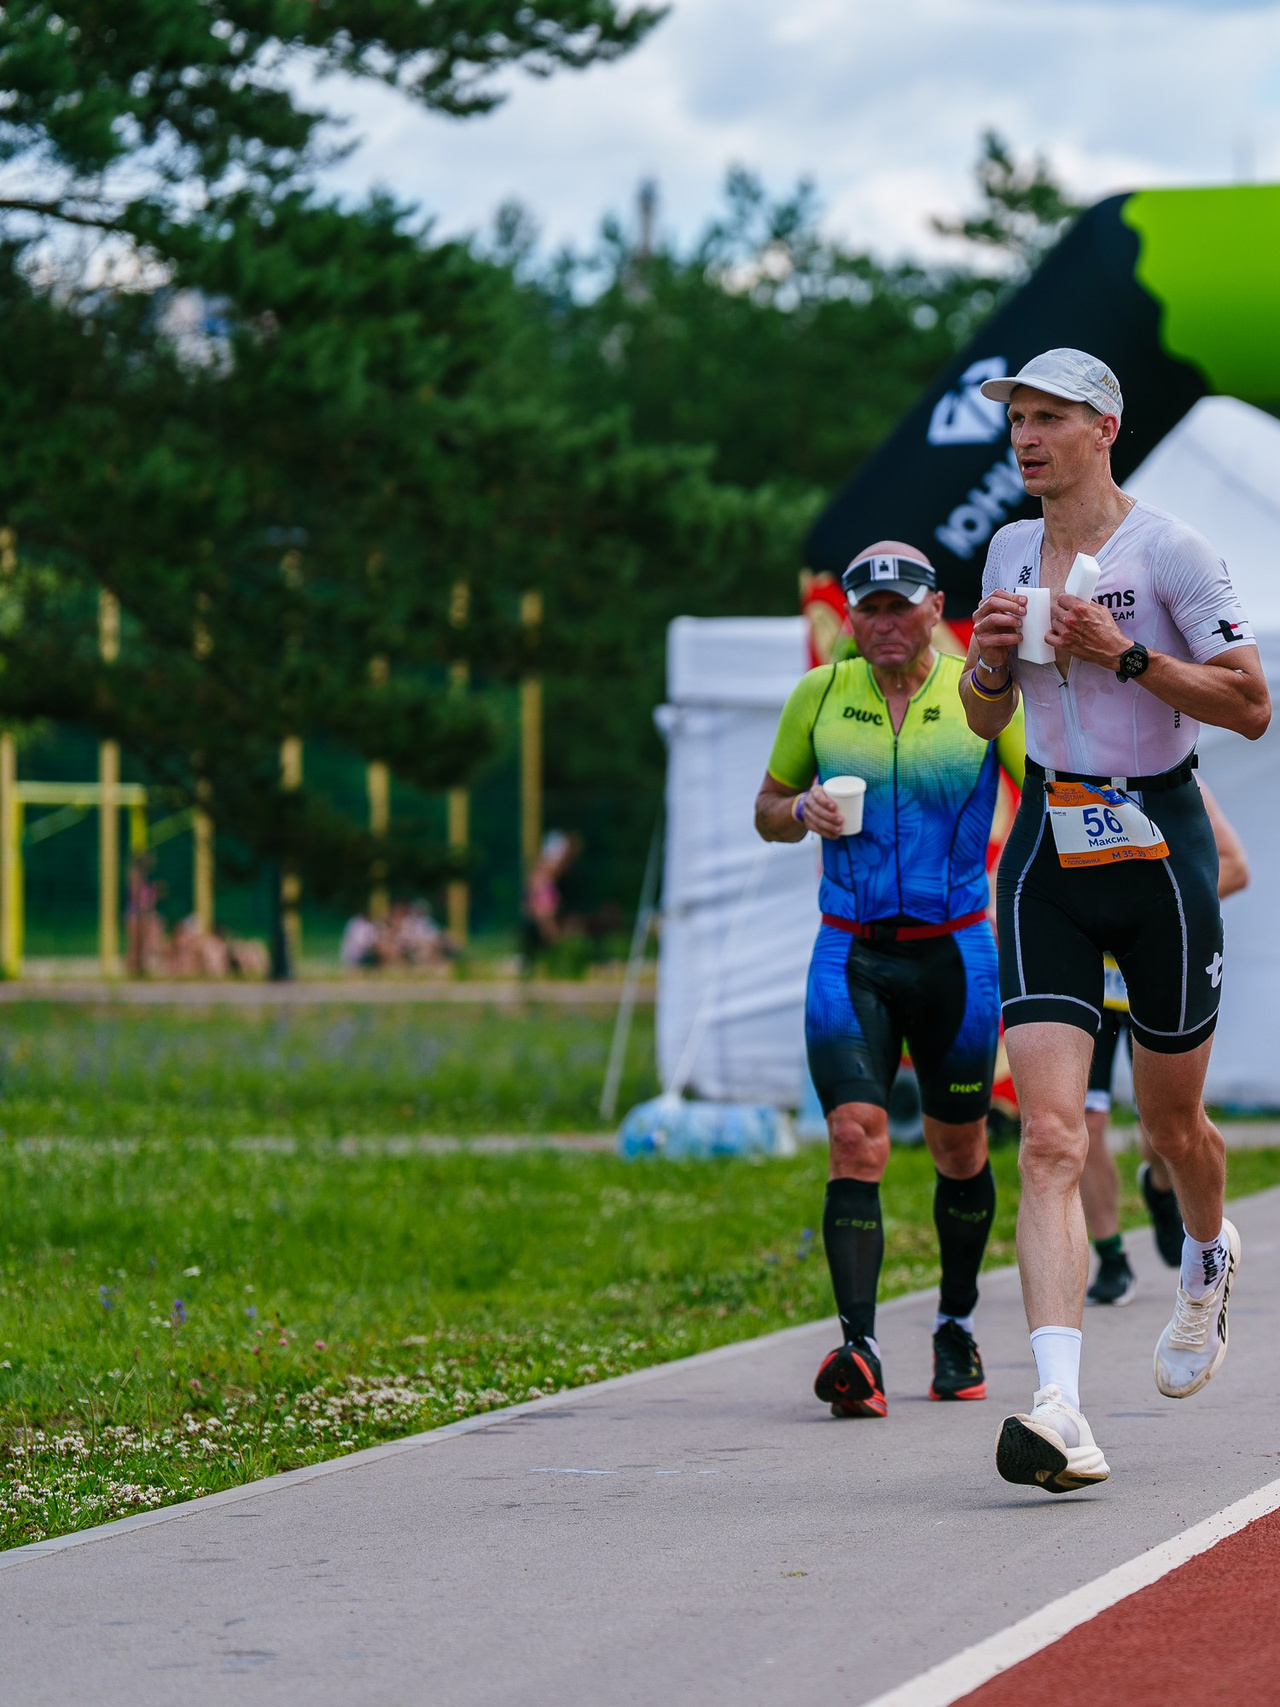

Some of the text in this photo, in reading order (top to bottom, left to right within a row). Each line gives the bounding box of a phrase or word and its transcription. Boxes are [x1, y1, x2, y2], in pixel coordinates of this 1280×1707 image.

[1091, 589, 1136, 609] ms
[843, 706, 884, 727] DWC
[1082, 807, 1124, 837] 56
[1088, 836, 1130, 848] Максим
